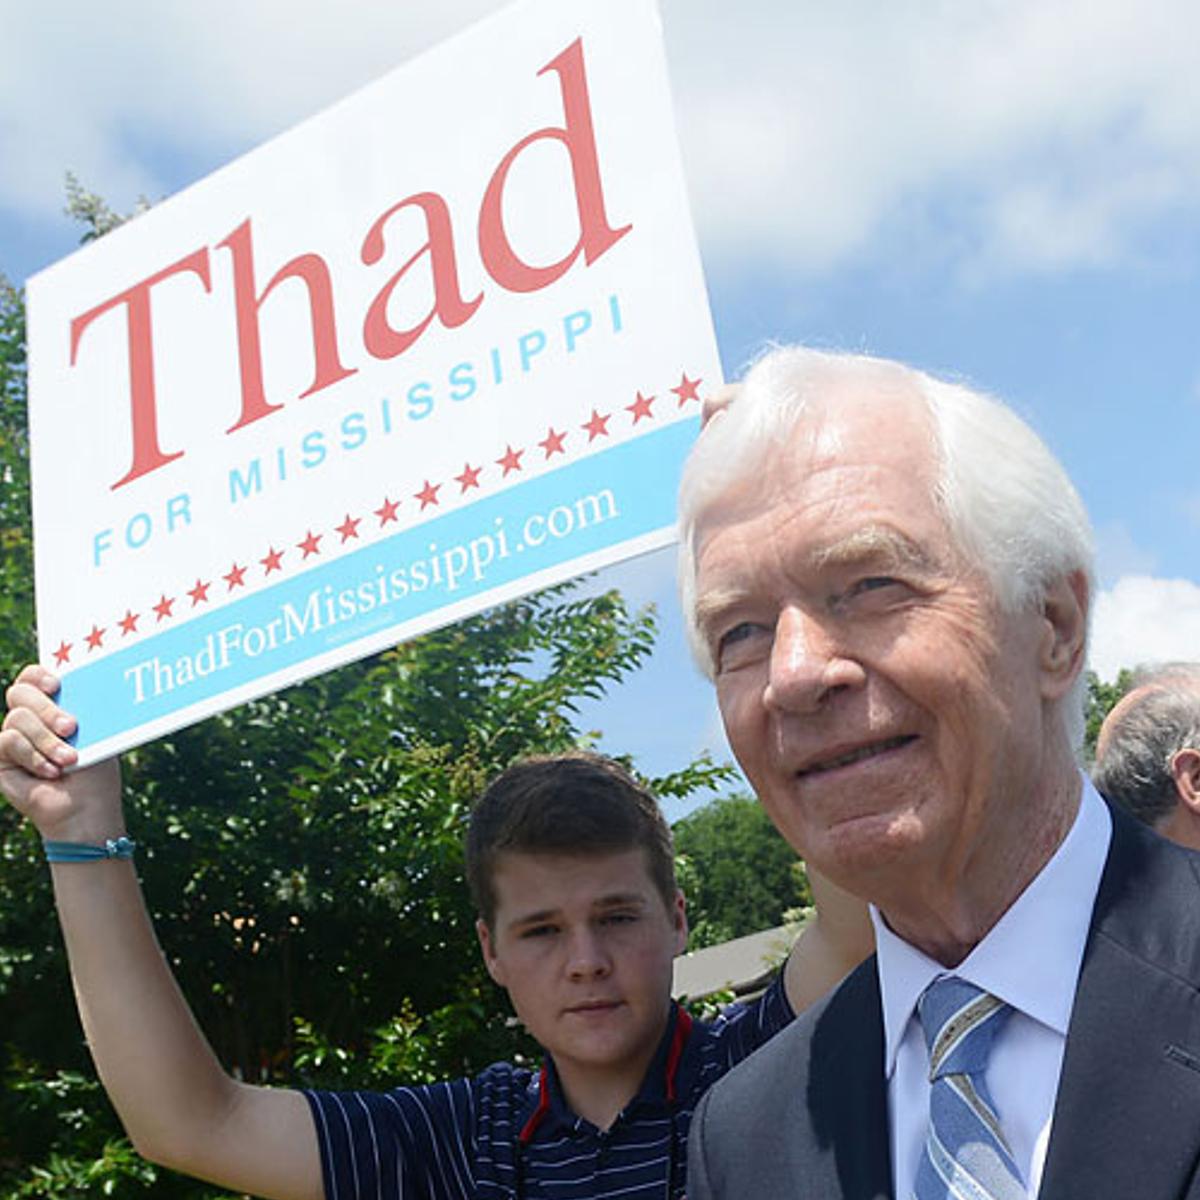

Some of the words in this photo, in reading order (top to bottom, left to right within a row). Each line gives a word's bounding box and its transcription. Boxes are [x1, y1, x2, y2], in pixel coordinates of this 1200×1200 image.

[70, 36, 633, 491] Thad
[92, 494, 193, 566] FOR
[228, 295, 624, 503] MISSISSIPPI
[124, 490, 620, 703] ThadForMississippi.com
